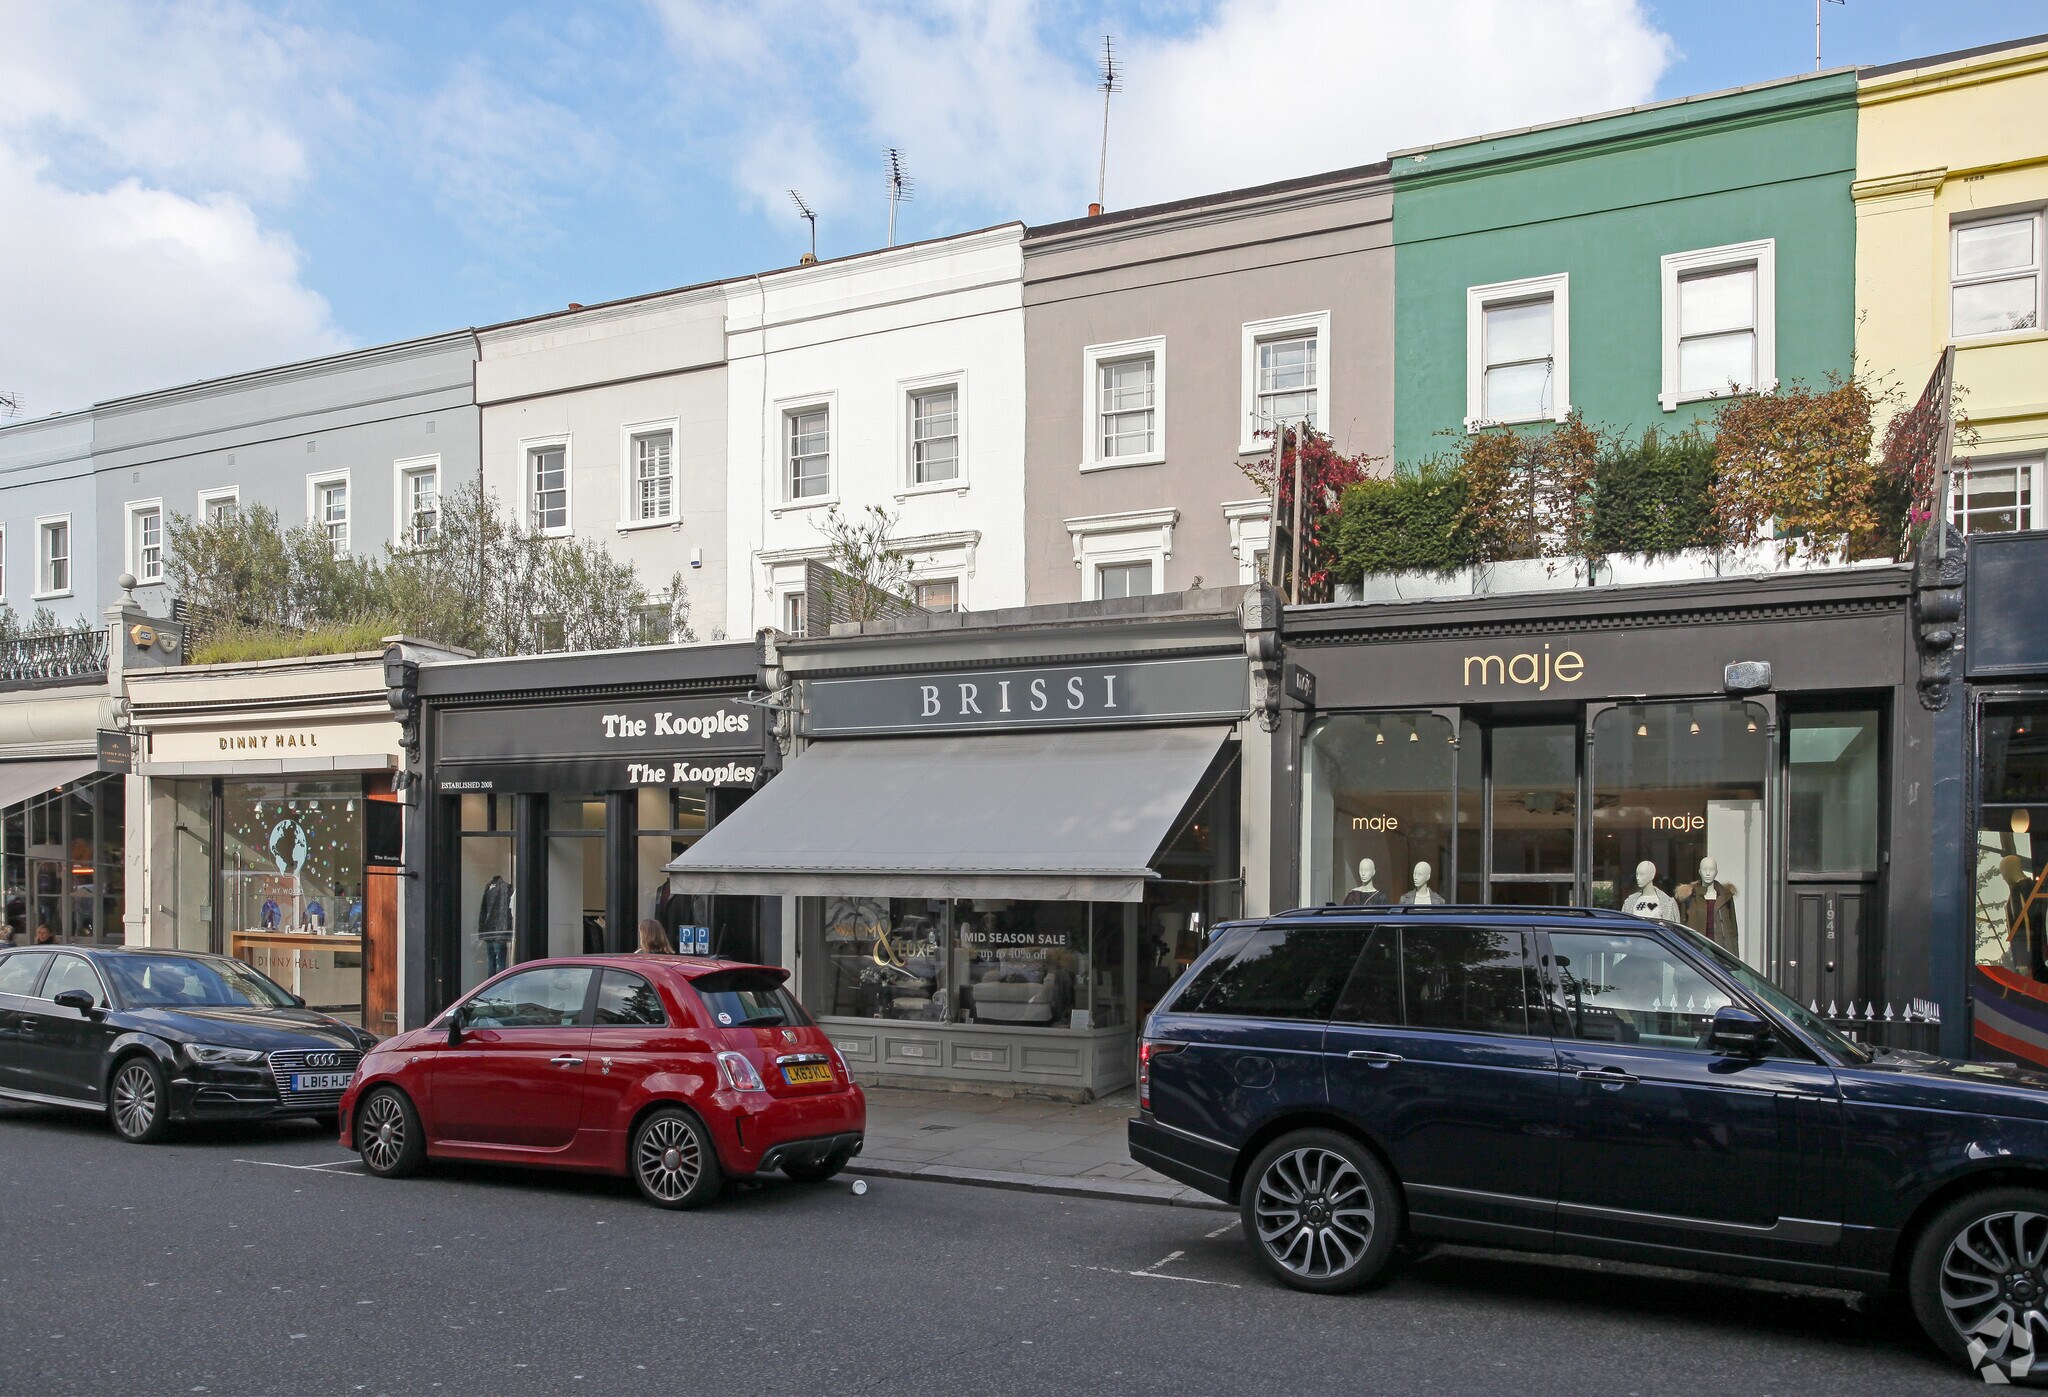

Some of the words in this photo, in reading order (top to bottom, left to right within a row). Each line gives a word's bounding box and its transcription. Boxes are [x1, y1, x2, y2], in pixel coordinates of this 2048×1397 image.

[1464, 643, 1584, 691] maje
[920, 675, 1117, 717] BRISSI
[602, 714, 647, 738] The
[654, 709, 749, 739] Kooples
[219, 735, 268, 750] DINNY
[275, 733, 317, 747] HALL
[627, 763, 666, 784] The
[672, 762, 756, 786] Kooples
[441, 781, 480, 789] ESTABLISHED
[1352, 813, 1398, 833] maje
[1652, 812, 1705, 833] maje
[272, 887, 281, 895] MY
[1826, 899, 1835, 940] 194a
[698, 929, 706, 942] P
[964, 932, 986, 943] MID
[989, 933, 1034, 944] SEASON
[1038, 934, 1066, 945] SALE
[898, 942, 936, 958] LUXE
[980, 949, 993, 961] up
[996, 949, 1006, 959] to
[1008, 947, 1031, 959] 40%
[1033, 948, 1048, 960] off
[258, 956, 291, 967] DINNY
[295, 957, 320, 970] HALL
[787, 1067, 813, 1081] LK63
[302, 1076, 328, 1089] LB15
